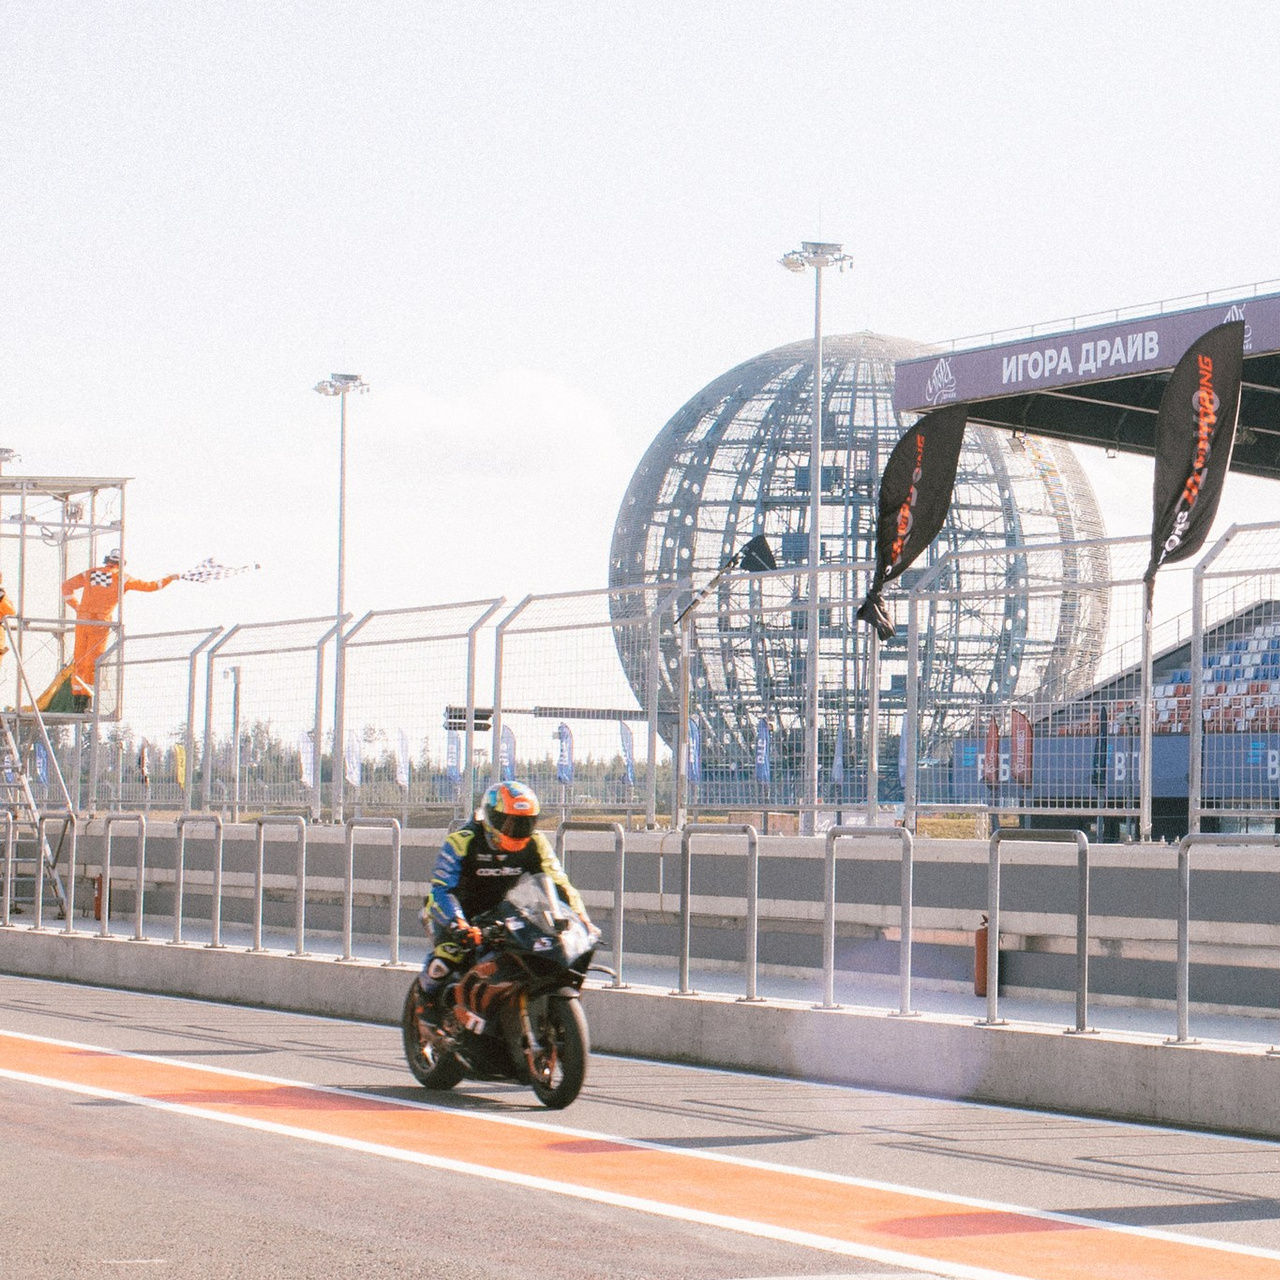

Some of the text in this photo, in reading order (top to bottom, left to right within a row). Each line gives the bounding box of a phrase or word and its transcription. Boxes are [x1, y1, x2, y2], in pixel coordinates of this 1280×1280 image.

[1002, 330, 1160, 385] ИГОРА ДРАЙВ
[1114, 752, 1141, 781] ВТ
